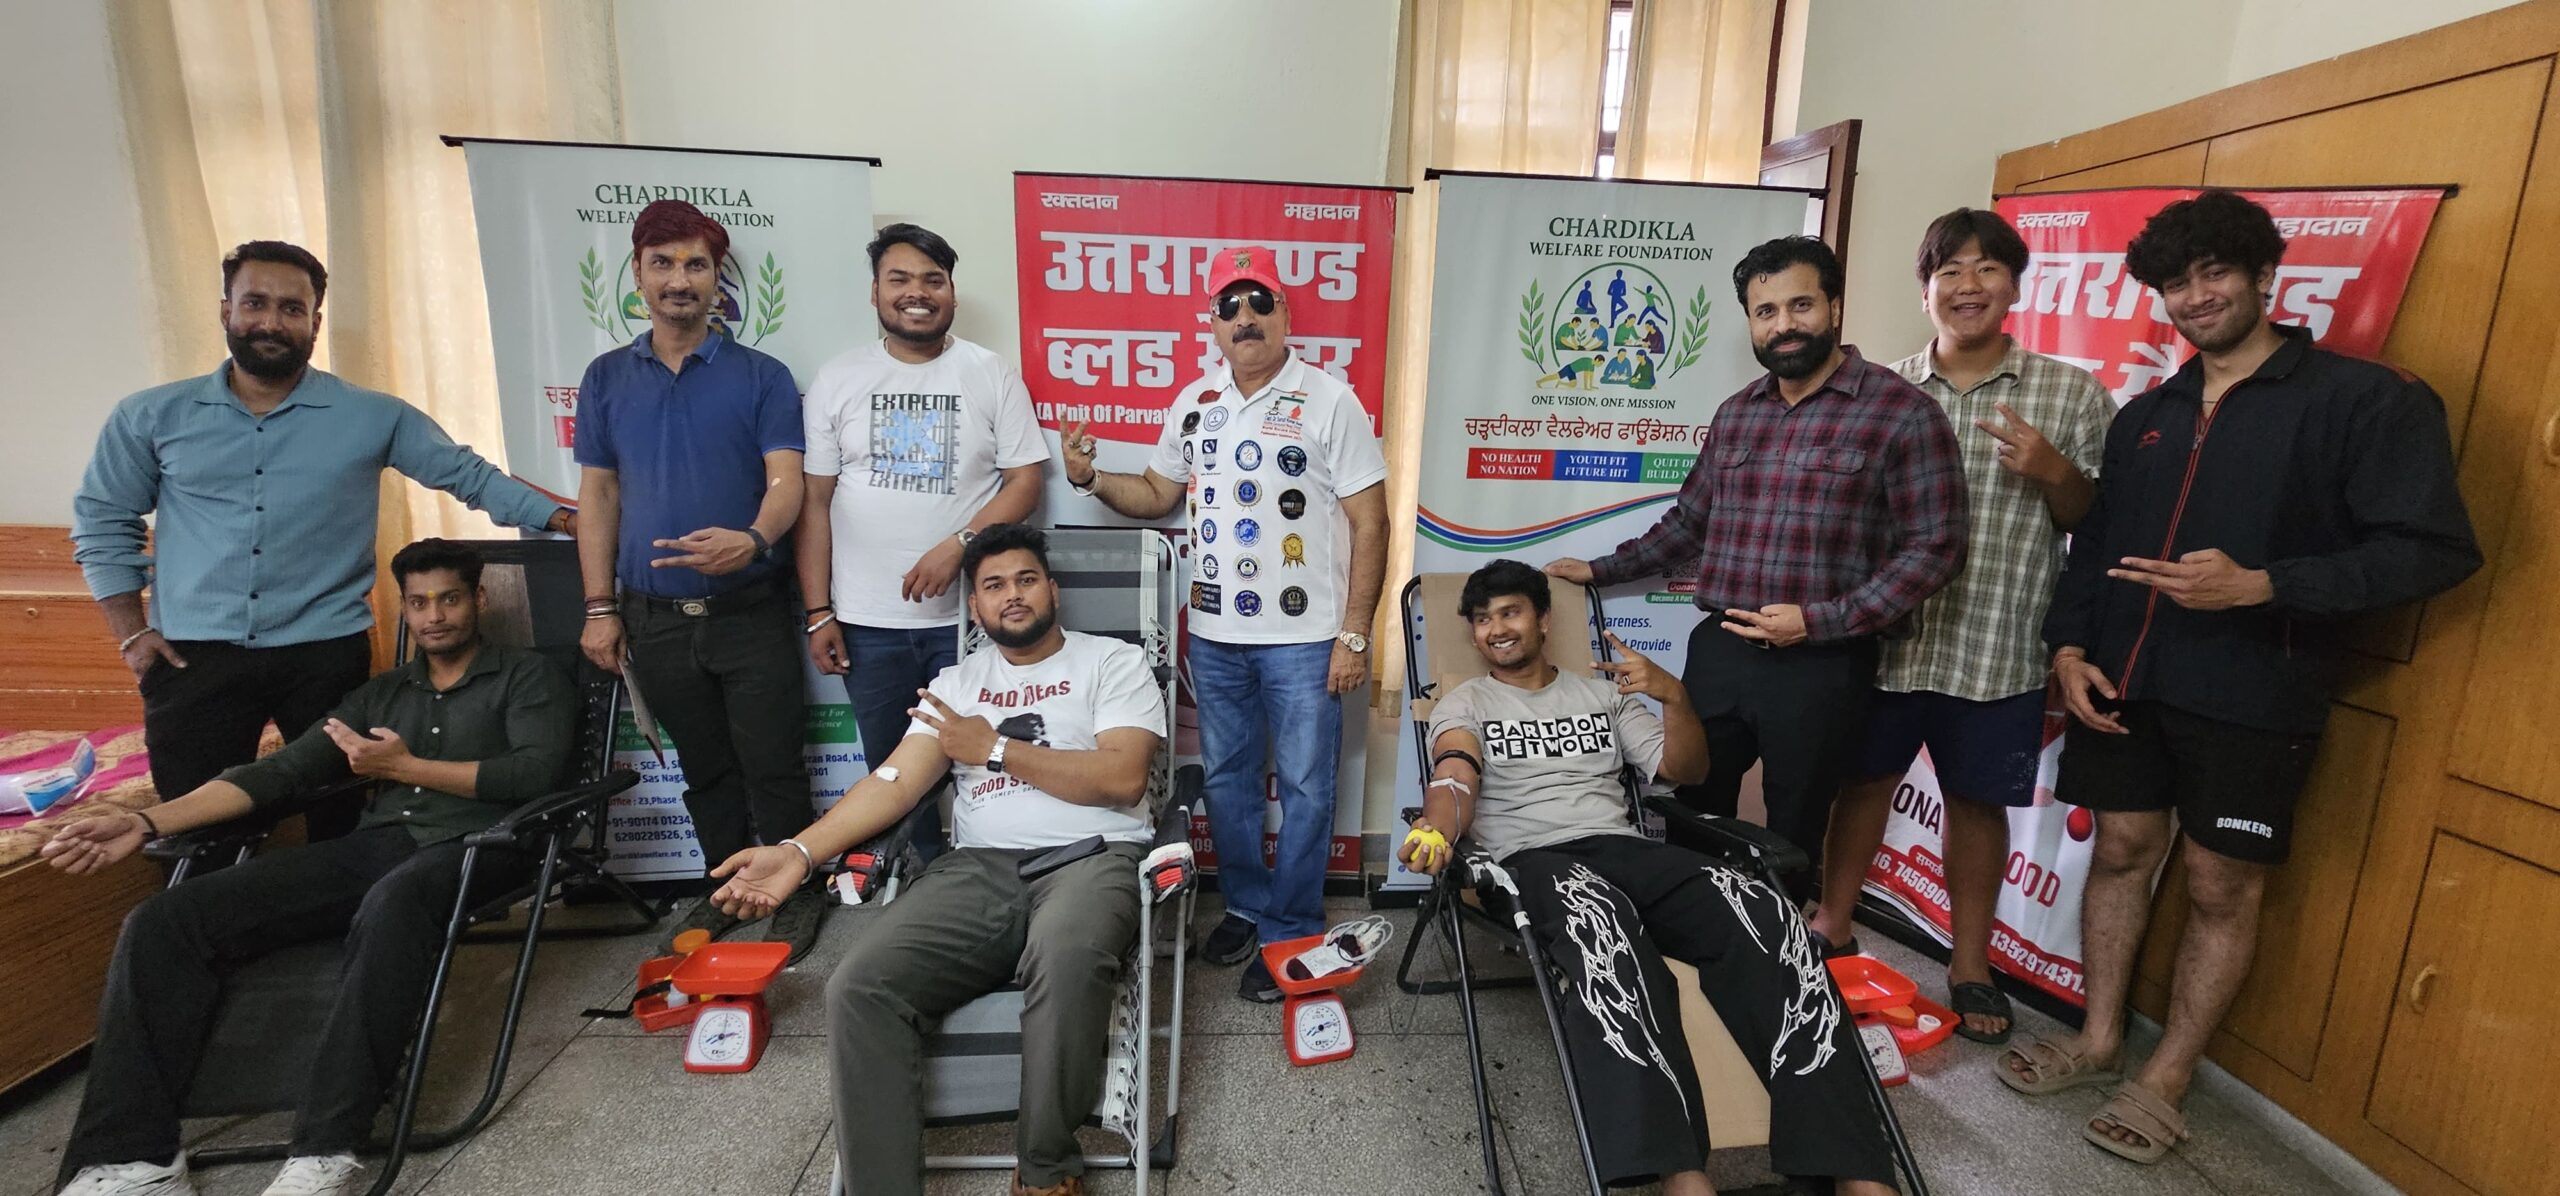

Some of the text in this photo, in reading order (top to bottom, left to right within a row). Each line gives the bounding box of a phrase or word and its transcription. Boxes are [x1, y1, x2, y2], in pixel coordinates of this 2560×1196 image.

[1041, 192, 1118, 210] रक्तदान
[1284, 203, 1360, 221] महादान
[2015, 211, 2091, 230] रक्तदान
[1549, 217, 1695, 241] CHARDIKLA
[1530, 241, 1713, 261] WELFARE FOUNDATION
[1041, 231, 1365, 302] उत्तराण्ड
[1043, 328, 1180, 389] ब्लड
[871, 393, 962, 412] EXTREME
[1531, 396, 1676, 410] ONE VISION, ONE MISSION
[1093, 404, 1112, 423] Of
[1481, 453, 1542, 464] NO HEALTH
[1569, 455, 1627, 466] YOUTH FIT
[1653, 458, 1681, 469] QUIT
[1480, 465, 1538, 476] NO NATION
[1565, 467, 1629, 478] FUTURE HIT
[1646, 469, 1679, 480] BUILD
[1589, 616, 1653, 628] Aareness.
[1630, 639, 1672, 652] Provide
[977, 687, 1019, 708] BAD
[1485, 714, 1611, 738] CARTOON
[1491, 733, 1615, 756] NETWORK
[825, 753, 851, 764] Road,
[642, 774, 685, 784] Sas Naga
[971, 776, 1006, 800] GOOD
[811, 789, 845, 798] rakhand
[2216, 817, 2273, 839] BONKERS
[2003, 850, 2061, 908] OOD
[1989, 929, 2085, 996] 135297431
